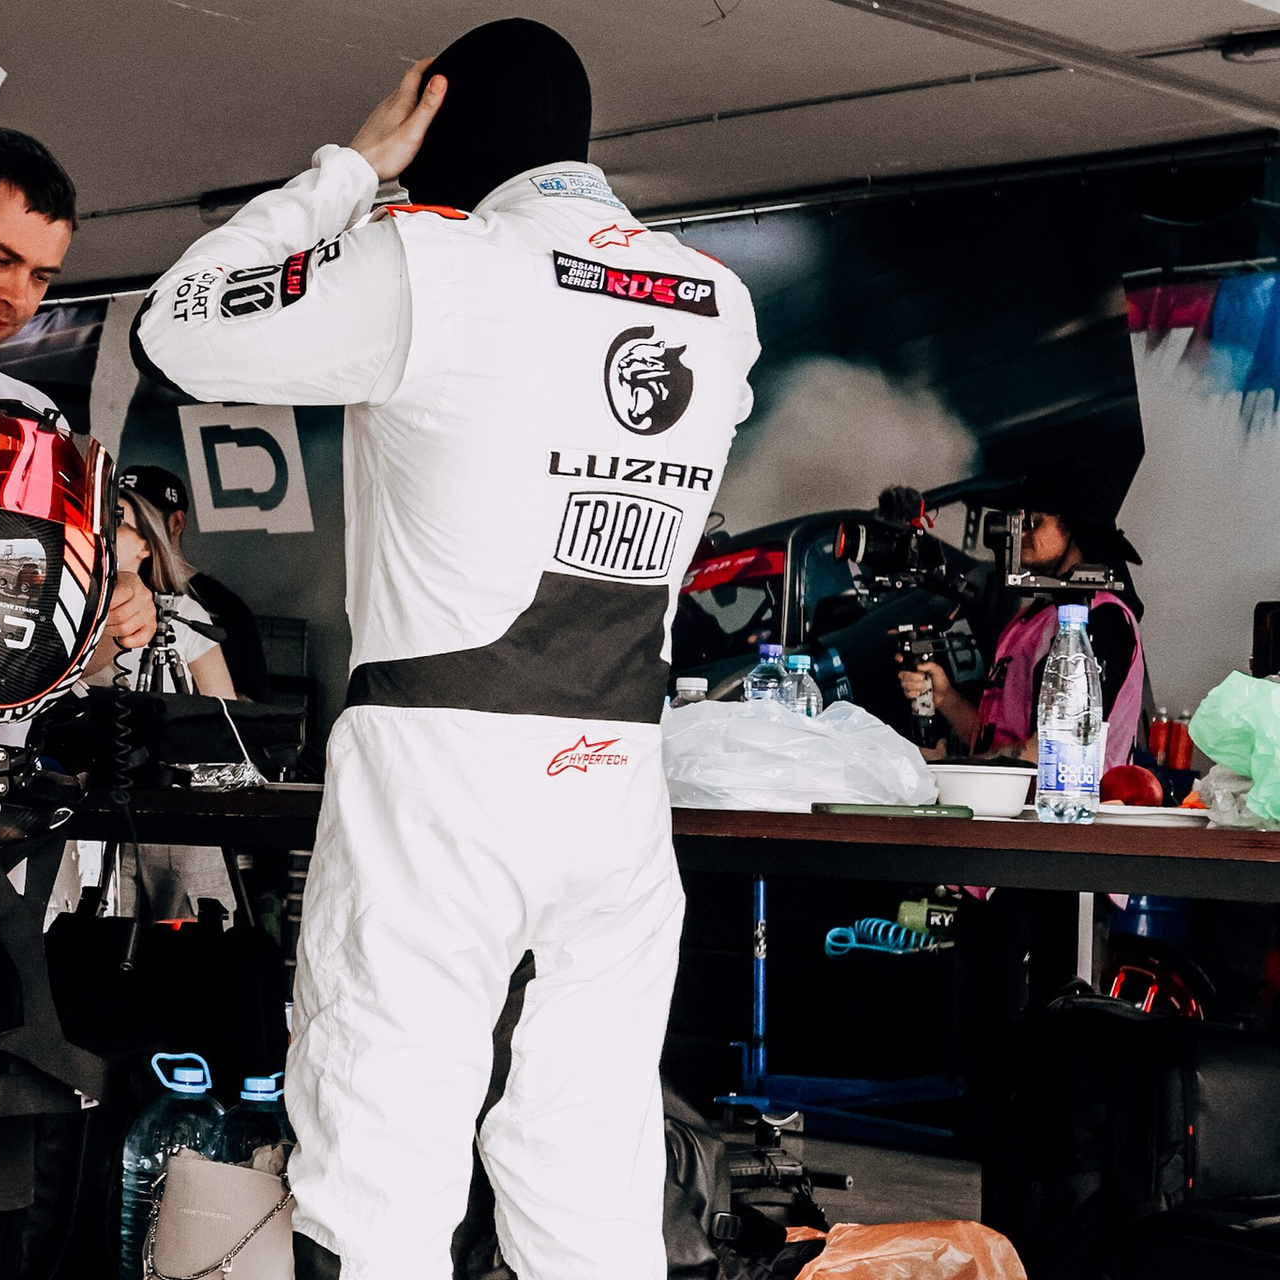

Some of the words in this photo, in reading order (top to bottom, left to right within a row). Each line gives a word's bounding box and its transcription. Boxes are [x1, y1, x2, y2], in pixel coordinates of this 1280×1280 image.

[557, 256, 601, 274] RUSSIAN
[560, 274, 598, 290] SERIES
[568, 268, 600, 281] DRIFT
[606, 270, 678, 304] RDS
[677, 281, 712, 303] GP
[192, 271, 218, 320] START
[548, 451, 714, 492] LUZAR
[165, 487, 178, 503] 45
[567, 500, 677, 571] TRIALLI
[569, 753, 628, 765] HYPERTECH
[1058, 762, 1094, 774] bona
[1058, 773, 1094, 786] aqua
[931, 911, 954, 926] RY
